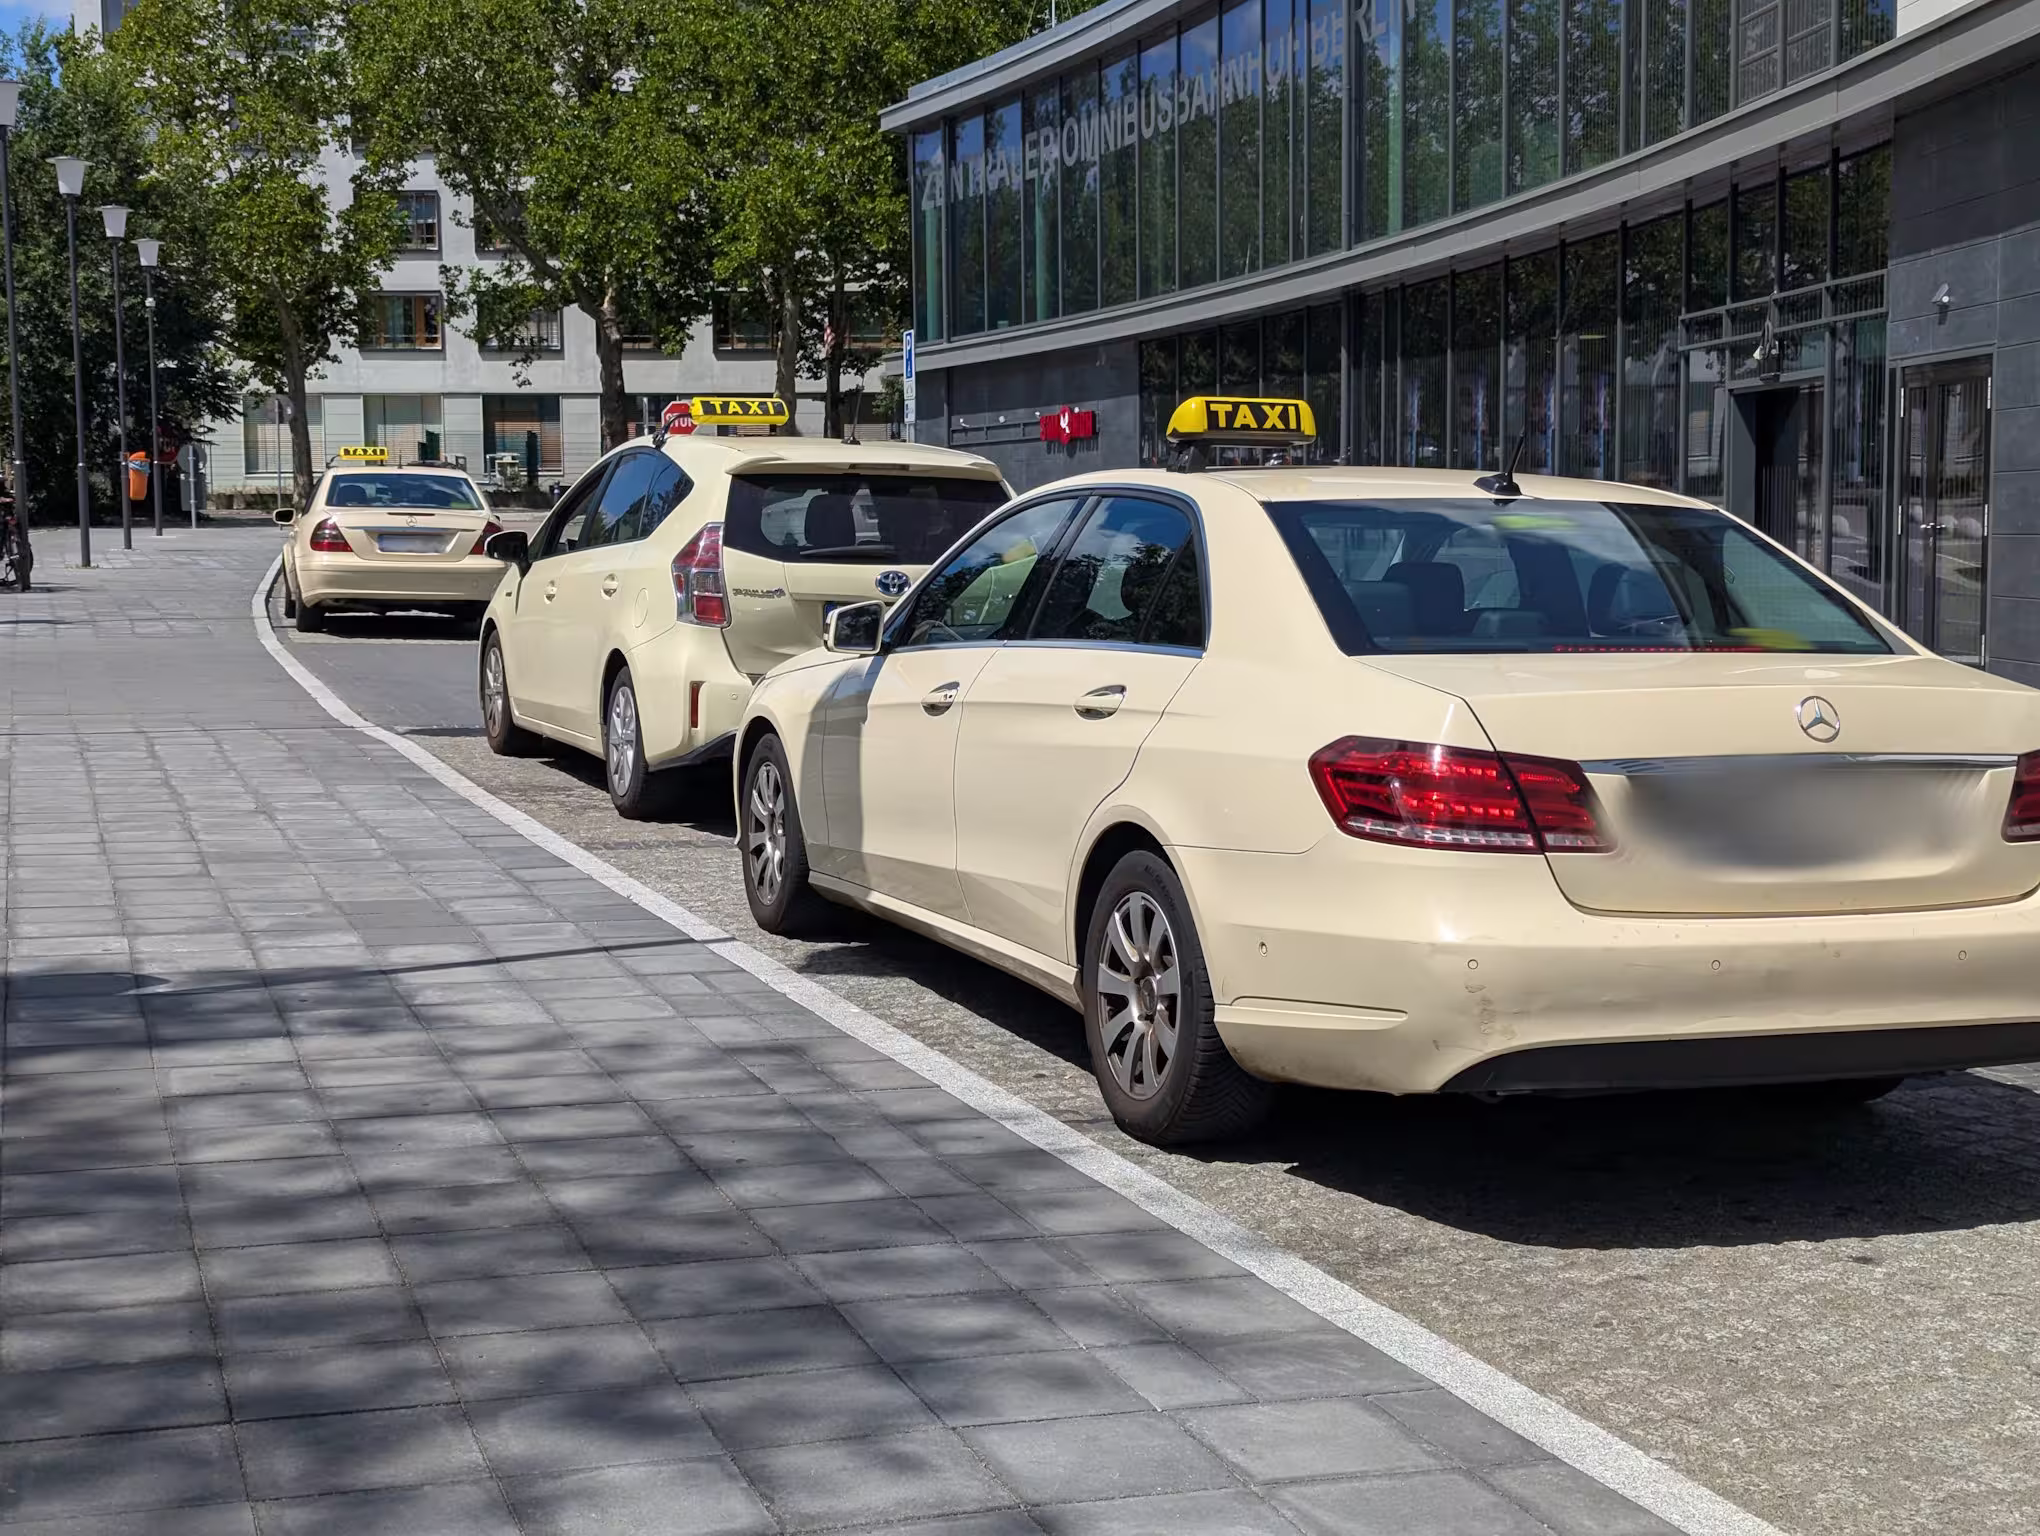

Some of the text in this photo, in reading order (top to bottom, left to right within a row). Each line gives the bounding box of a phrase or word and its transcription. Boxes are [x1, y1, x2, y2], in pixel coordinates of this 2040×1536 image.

[710, 401, 775, 414] TAXI
[1209, 403, 1297, 429] TAXI
[348, 448, 380, 456] TAXI
